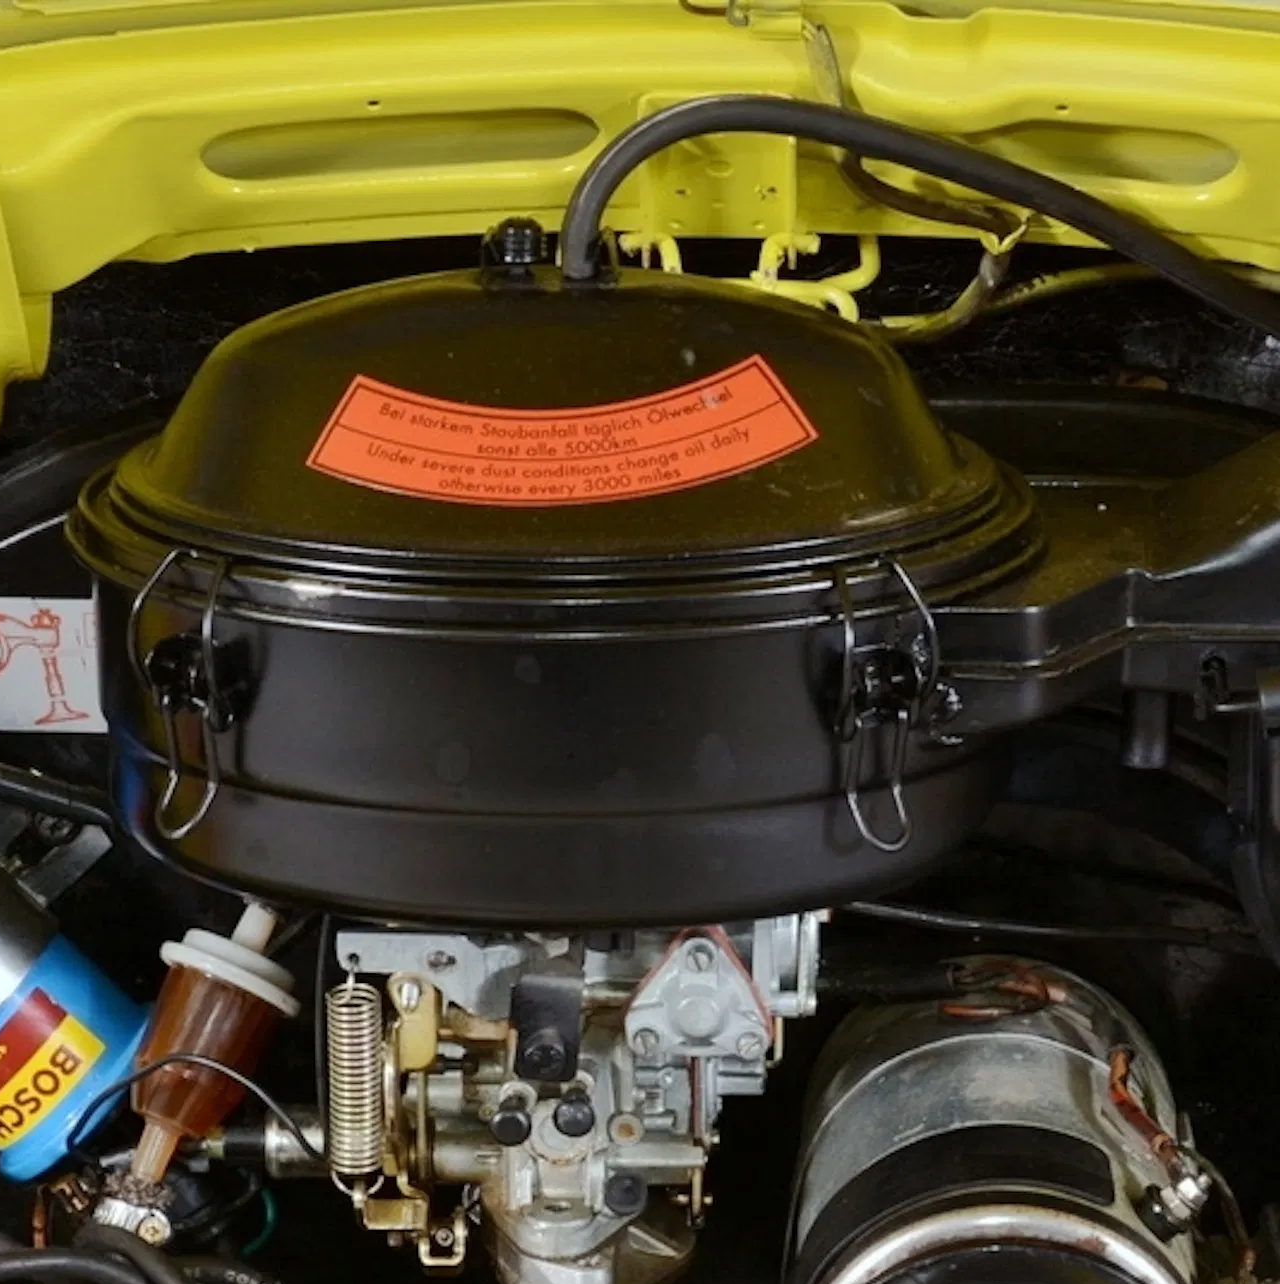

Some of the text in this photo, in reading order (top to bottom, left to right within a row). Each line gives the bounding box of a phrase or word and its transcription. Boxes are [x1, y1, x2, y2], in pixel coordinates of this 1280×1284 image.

[378, 402, 406, 420] Bei
[409, 413, 474, 434] starkem
[479, 422, 579, 440] Staubanfall
[368, 426, 749, 479] Under severe dust conditions change oil daily
[476, 442, 520, 457] sonst
[525, 441, 558, 457] alle
[438, 467, 682, 497] otherwise every 3000 miles
